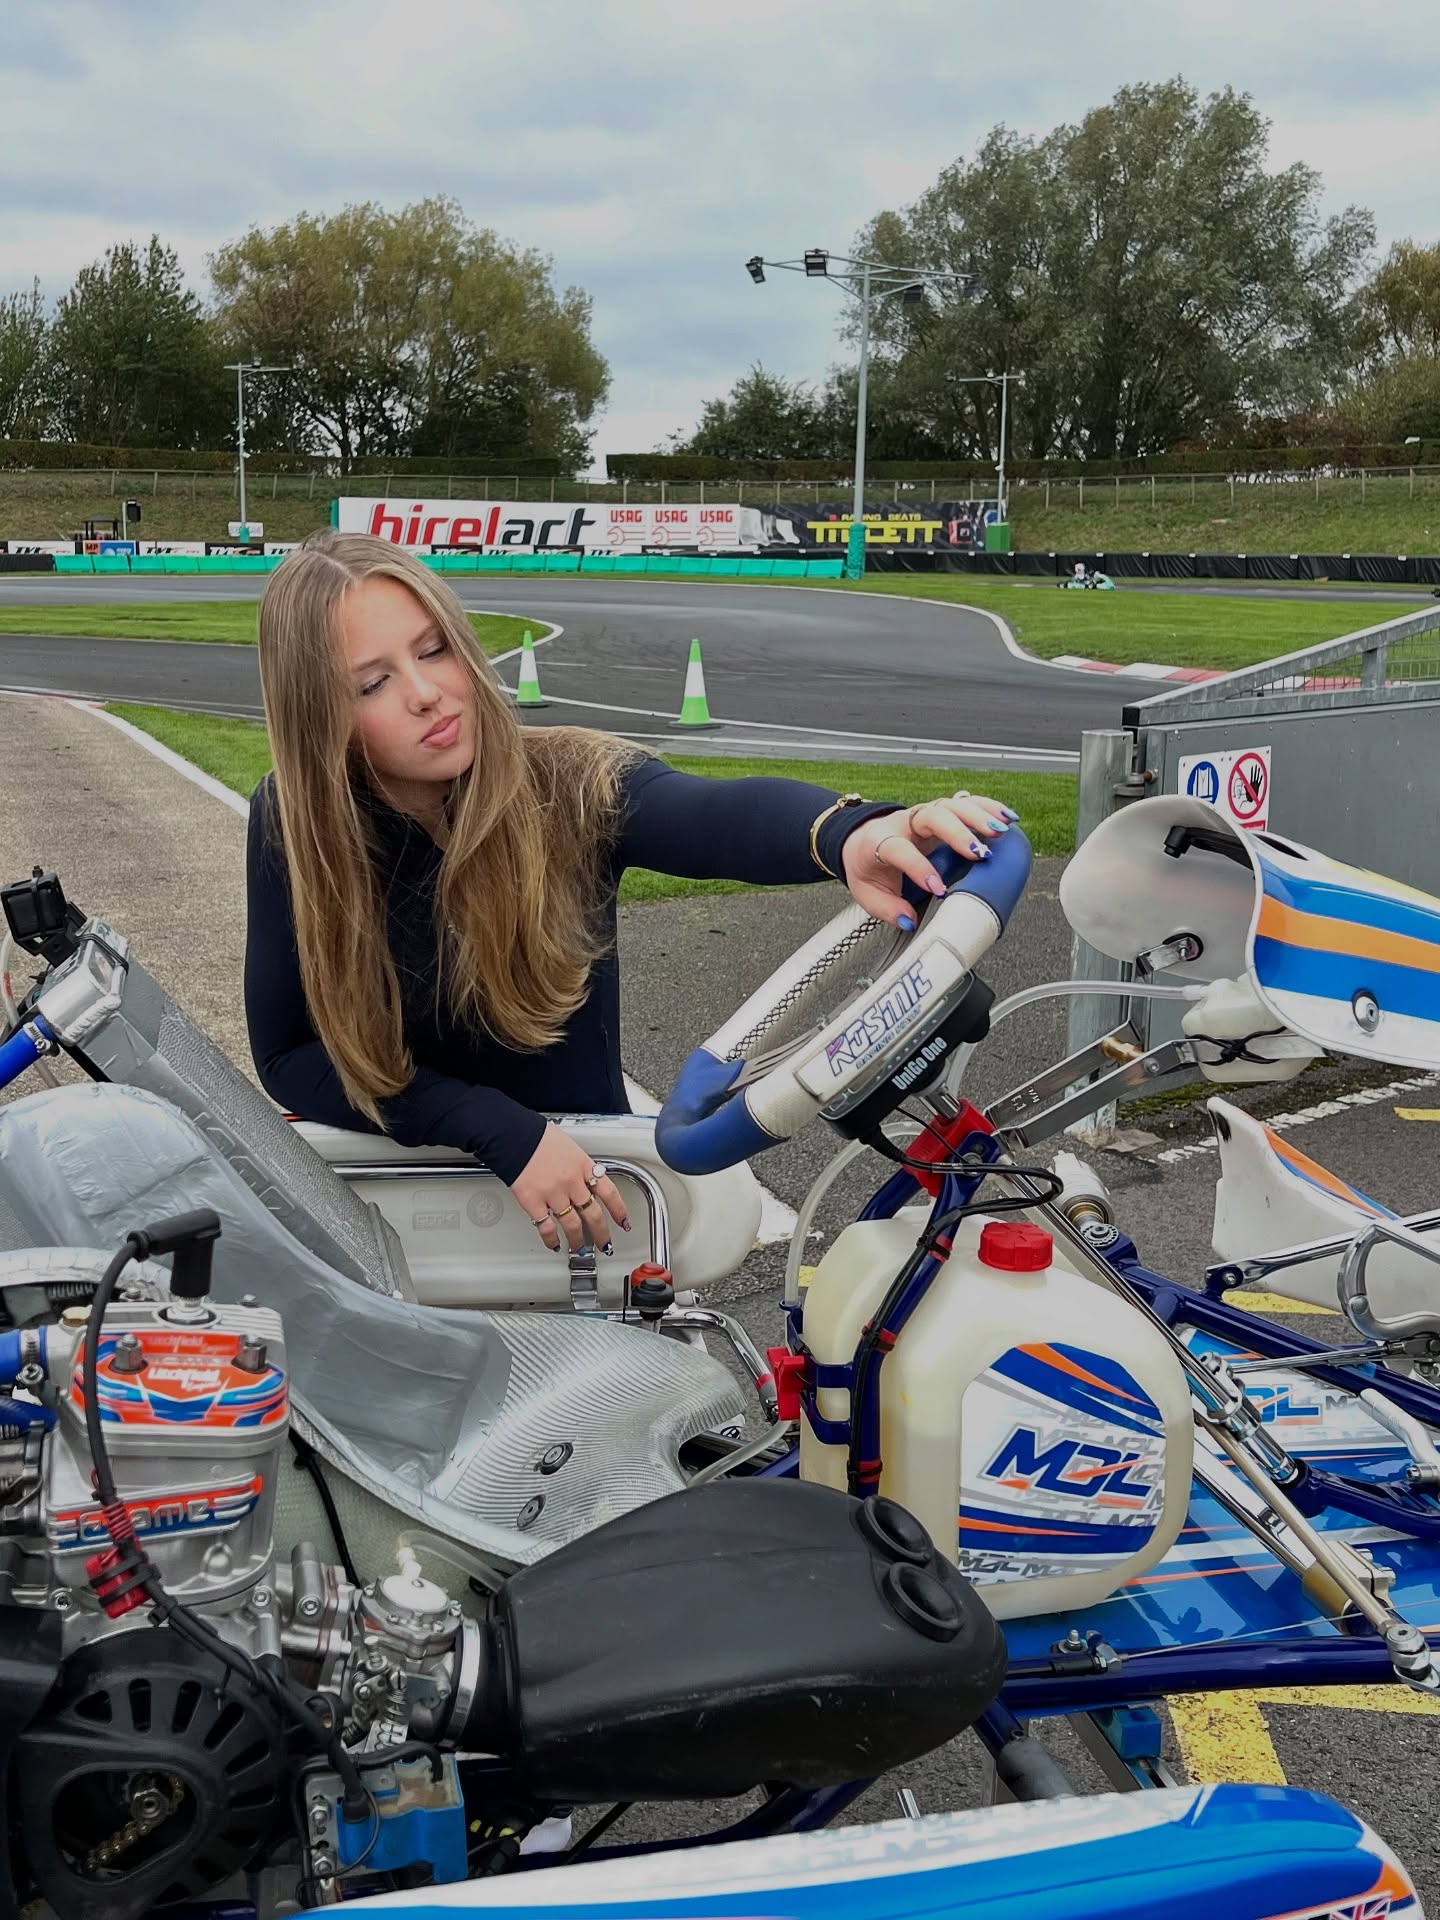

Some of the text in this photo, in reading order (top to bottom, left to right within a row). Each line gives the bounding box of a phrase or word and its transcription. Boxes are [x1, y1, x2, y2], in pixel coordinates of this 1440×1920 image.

[610, 510, 642, 523] USAG
[655, 510, 688, 523] USAG
[700, 510, 733, 523] USAG
[841, 513, 881, 521] RAING
[921, 1037, 948, 1061] One
[1243, 1386, 1320, 1423] DL
[983, 1427, 1154, 1498] MDL
